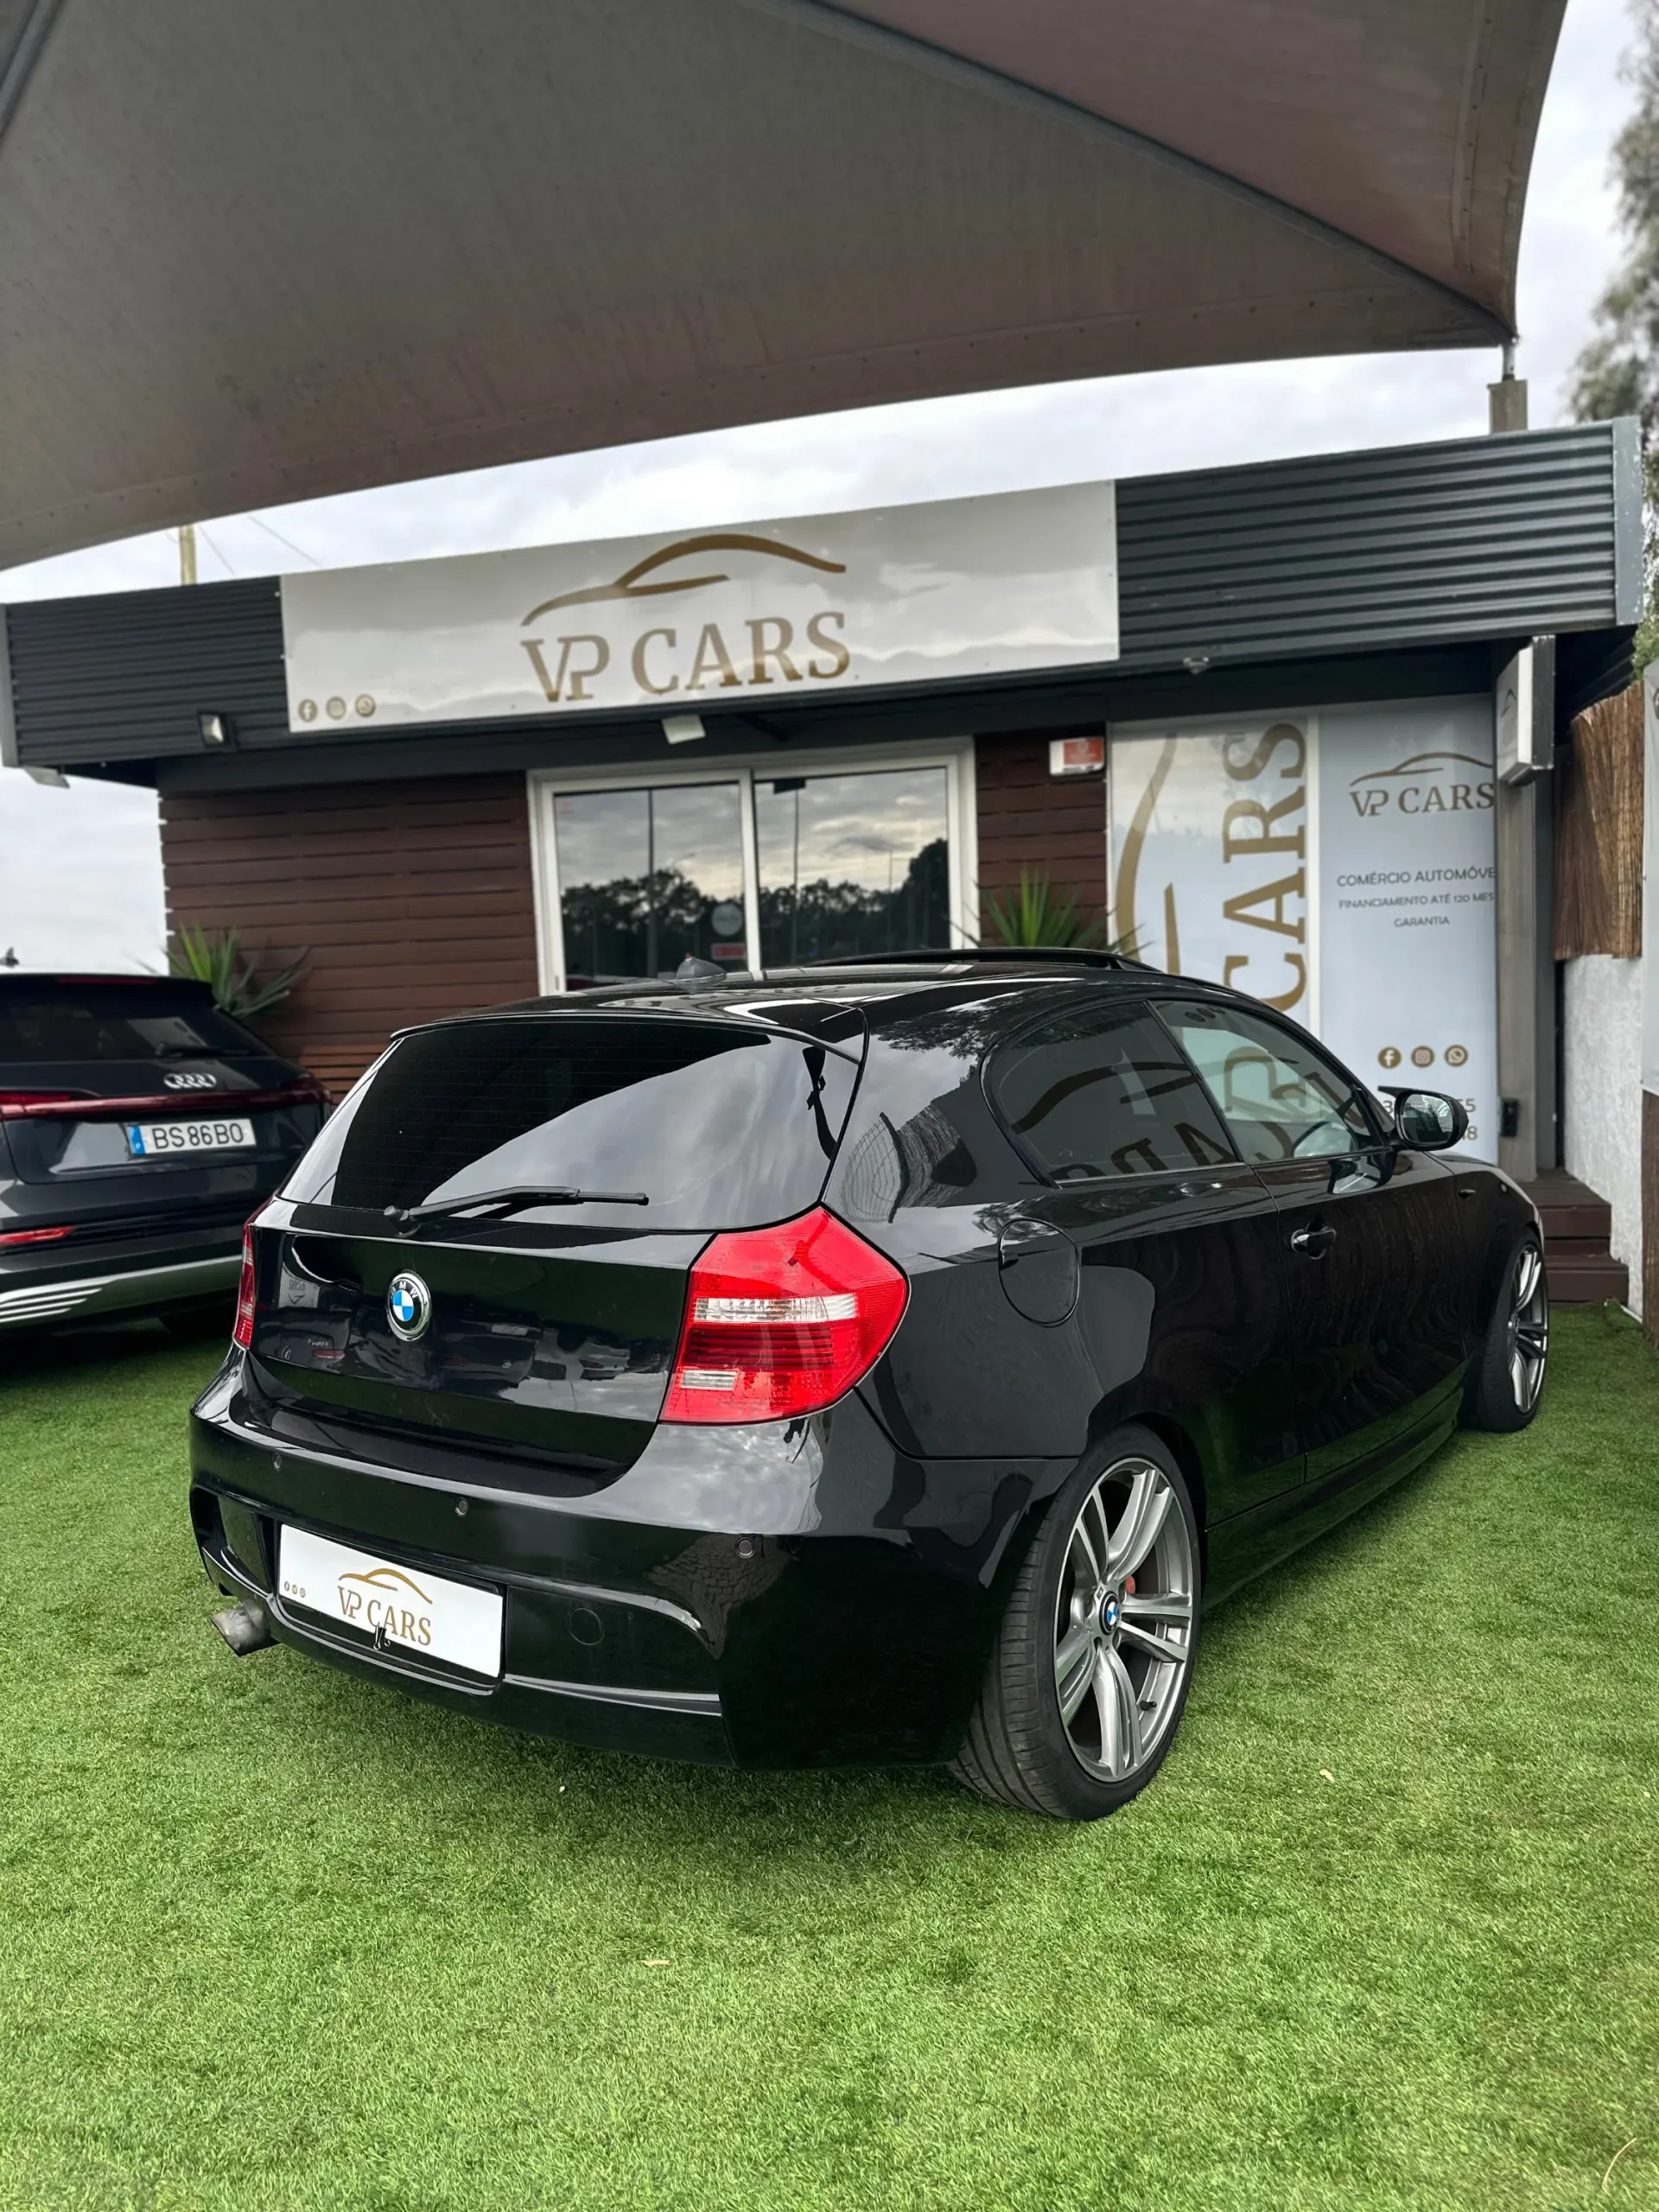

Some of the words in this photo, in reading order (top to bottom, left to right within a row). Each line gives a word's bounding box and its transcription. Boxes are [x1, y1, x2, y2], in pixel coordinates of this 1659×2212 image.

[520, 633, 610, 702] VP
[631, 611, 850, 696] CARS
[1349, 789, 1389, 817] VP
[1398, 782, 1496, 814] CARS
[1337, 871, 1411, 887] COMÉRCIO
[1339, 895, 1428, 909] FINANCIAMENTO
[1430, 893, 1451, 904] ATÉ
[1453, 895, 1471, 904] 120
[1394, 916, 1450, 928] GARANTIA
[337, 1586, 362, 1619] VP
[367, 1599, 431, 1646] CARS
